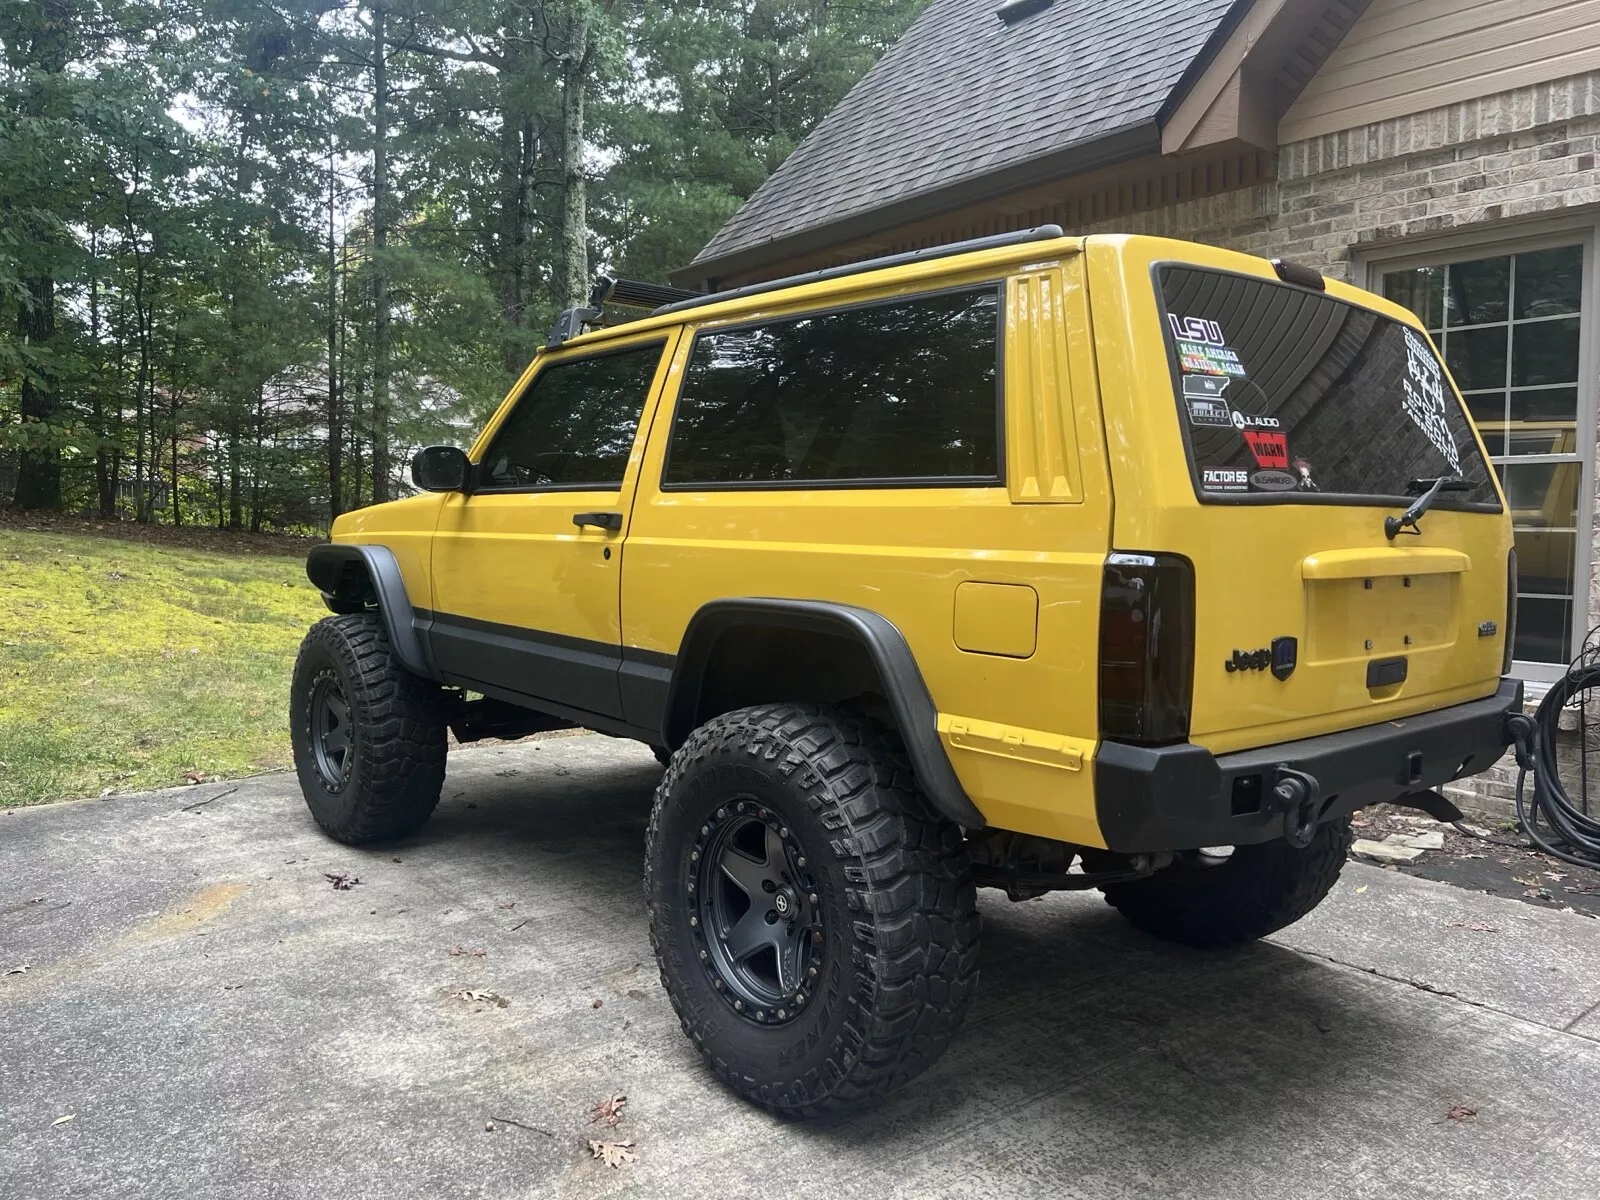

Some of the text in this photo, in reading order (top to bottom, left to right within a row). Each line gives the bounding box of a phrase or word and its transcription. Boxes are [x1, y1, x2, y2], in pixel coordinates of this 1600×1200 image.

[1167, 313, 1225, 347] LSU
[1181, 344, 1239, 362] MAKE AMERICA
[1183, 357, 1245, 375] GRATEFUL AGAIN
[1193, 409, 1227, 417] BULLET
[1244, 416, 1280, 427] JL AUDIO
[1402, 401, 1463, 477] FABRICATION
[1425, 414, 1459, 462] SOLID
[1253, 442, 1285, 458] WARN
[1203, 470, 1248, 483] FACTOR 55
[1253, 475, 1293, 485] BUSHWACKER
[1225, 648, 1271, 673] Jeep
